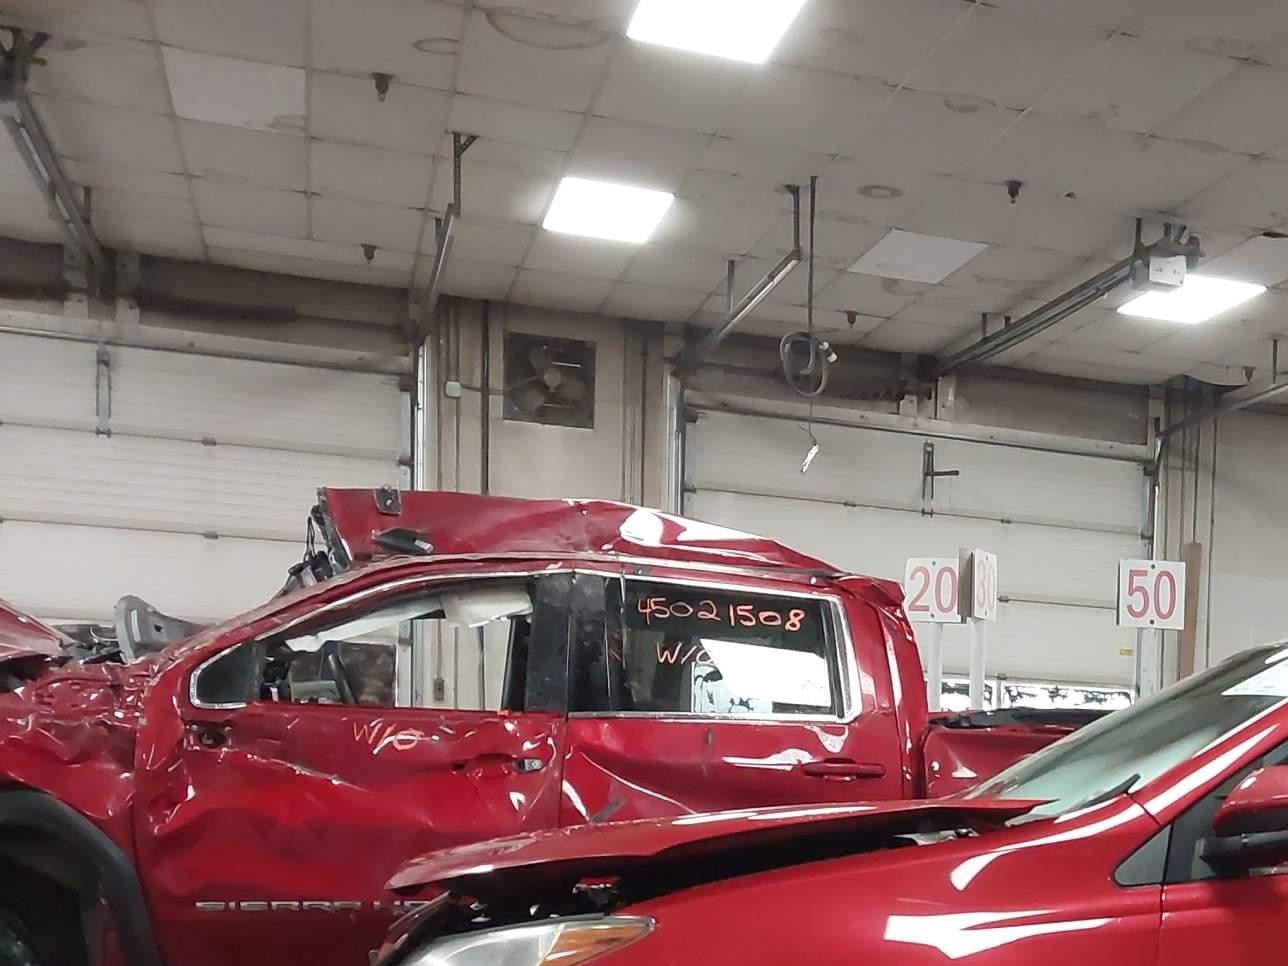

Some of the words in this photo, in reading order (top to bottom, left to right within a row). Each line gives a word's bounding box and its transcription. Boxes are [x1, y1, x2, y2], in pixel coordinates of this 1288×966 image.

[908, 565, 958, 613] 20
[976, 560, 995, 609] 30
[1126, 569, 1176, 620] 50
[637, 597, 806, 632] 45021508
[195, 901, 362, 911] SIERRA
